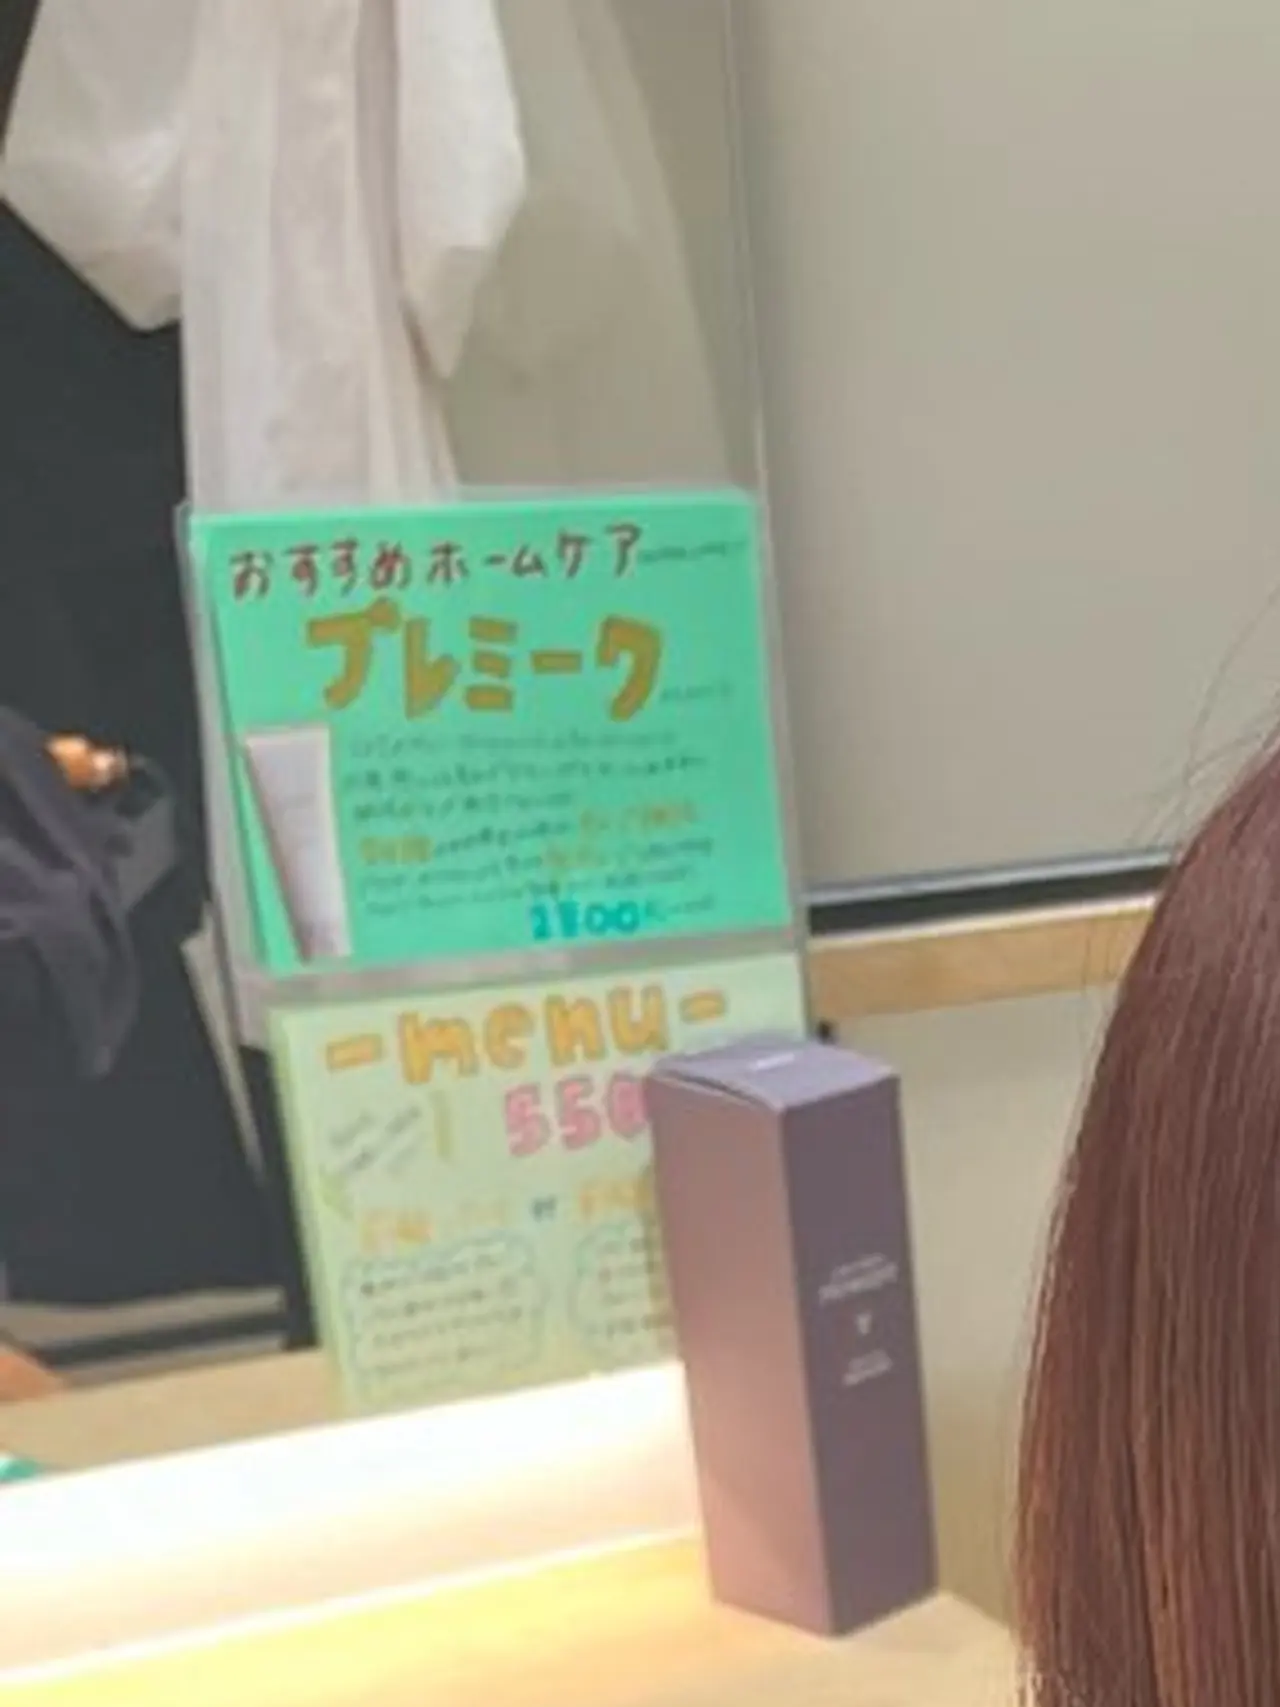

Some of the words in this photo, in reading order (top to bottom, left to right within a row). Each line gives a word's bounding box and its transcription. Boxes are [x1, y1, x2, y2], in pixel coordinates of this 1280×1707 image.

[306, 597, 663, 723] プレミーク
